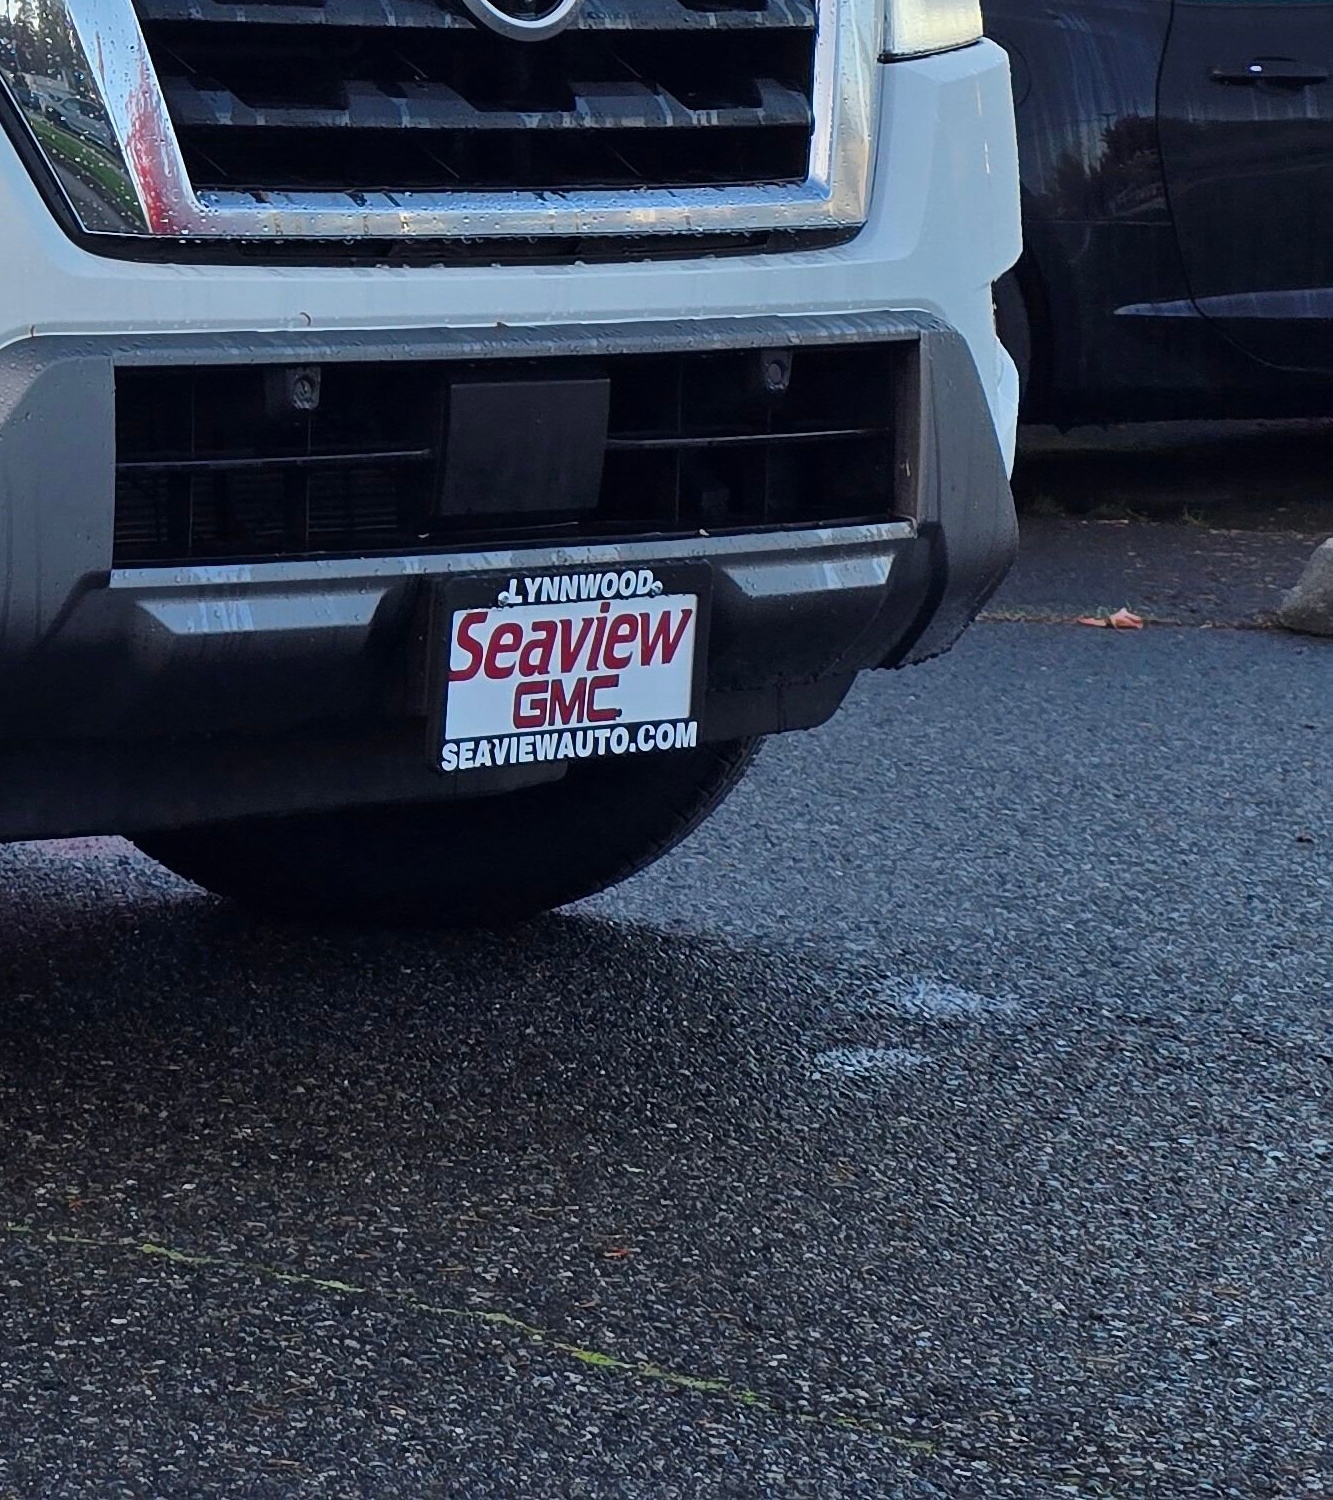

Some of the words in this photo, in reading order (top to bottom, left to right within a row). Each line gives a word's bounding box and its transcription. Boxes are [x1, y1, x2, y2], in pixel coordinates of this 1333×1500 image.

[509, 570, 653, 604] LYNNWOOD
[448, 602, 693, 682] Seaview
[513, 675, 621, 729] GMC
[442, 721, 698, 772] SEAVIEWAUTO.COM
